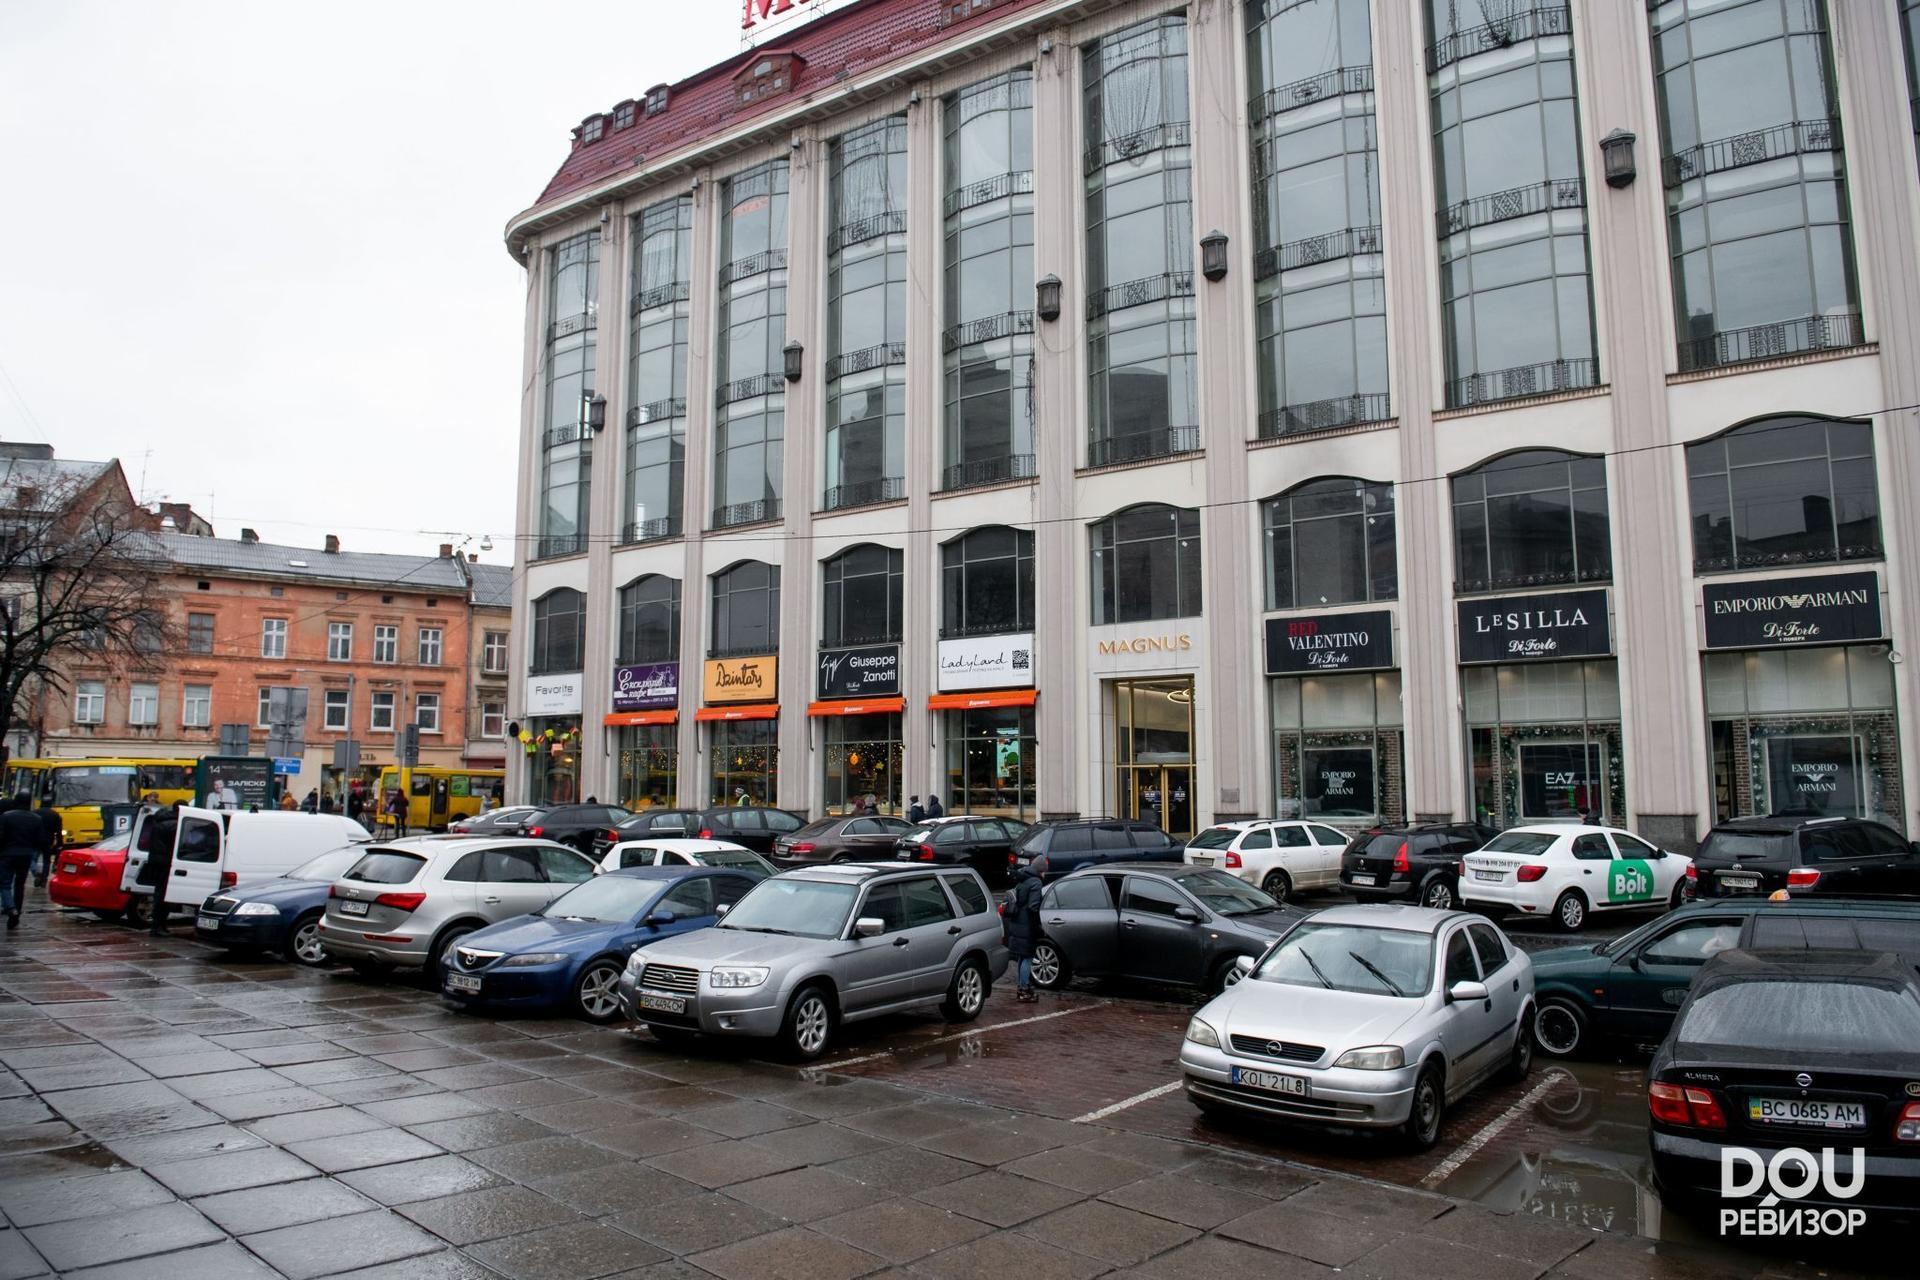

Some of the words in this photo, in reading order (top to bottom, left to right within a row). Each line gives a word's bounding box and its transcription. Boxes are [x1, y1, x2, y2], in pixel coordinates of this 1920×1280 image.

[1714, 596, 1784, 614] EMPORIO
[1805, 590, 1868, 608] ARMANI
[1288, 622, 1317, 636] RED
[1099, 634, 1191, 655] MAGNUS
[1288, 632, 1368, 650] VALENTINO
[849, 656, 896, 668] Giuseppe
[863, 669, 896, 682] Zanotti
[536, 684, 574, 695] Favorite
[209, 765, 221, 774] 14
[1791, 763, 1839, 772] EMPORIO
[1321, 771, 1356, 779] EMPORIO
[1545, 772, 1575, 784] EA7
[1325, 787, 1354, 795] ARMANI
[1796, 783, 1836, 792] ARMANI
[119, 817, 127, 828] P
[1615, 873, 1647, 896] Bolt
[645, 997, 655, 1008] BC
[1240, 1069, 1266, 1087] KOL
[1684, 1072, 1720, 1081] ALMERA
[1761, 1100, 1785, 1116] BC
[1790, 1102, 1829, 1120] 0685
[1834, 1105, 1860, 1121] AM
